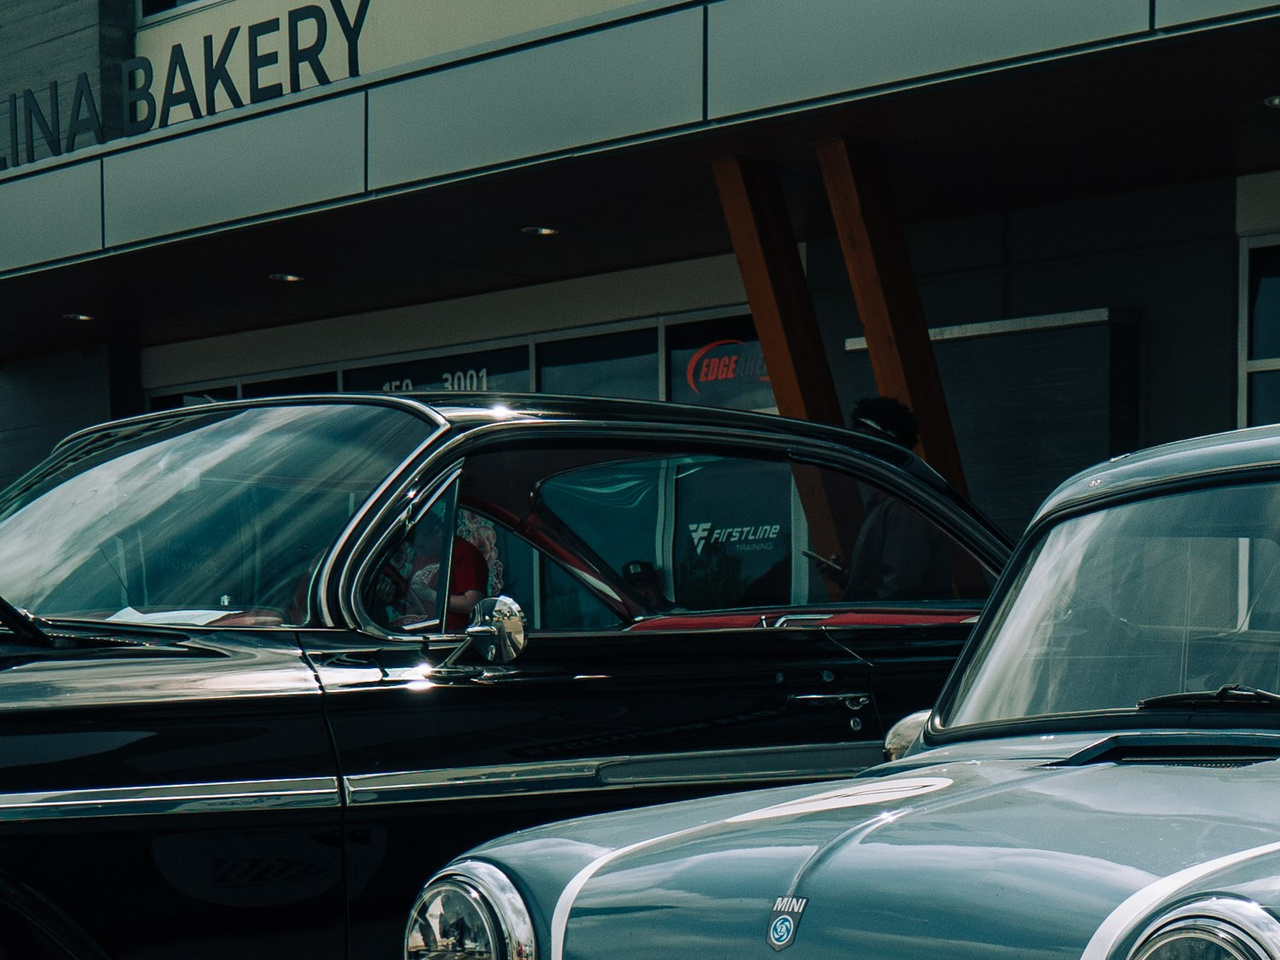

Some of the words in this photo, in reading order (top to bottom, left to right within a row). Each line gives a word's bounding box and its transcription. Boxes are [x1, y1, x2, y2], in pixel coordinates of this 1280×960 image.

[0, 72, 106, 170] INA
[121, 0, 371, 137] BAKERY
[442, 367, 488, 391] 3001
[698, 355, 738, 382] EDGE
[735, 541, 773, 552] TRAINING
[773, 897, 807, 913] MINI
